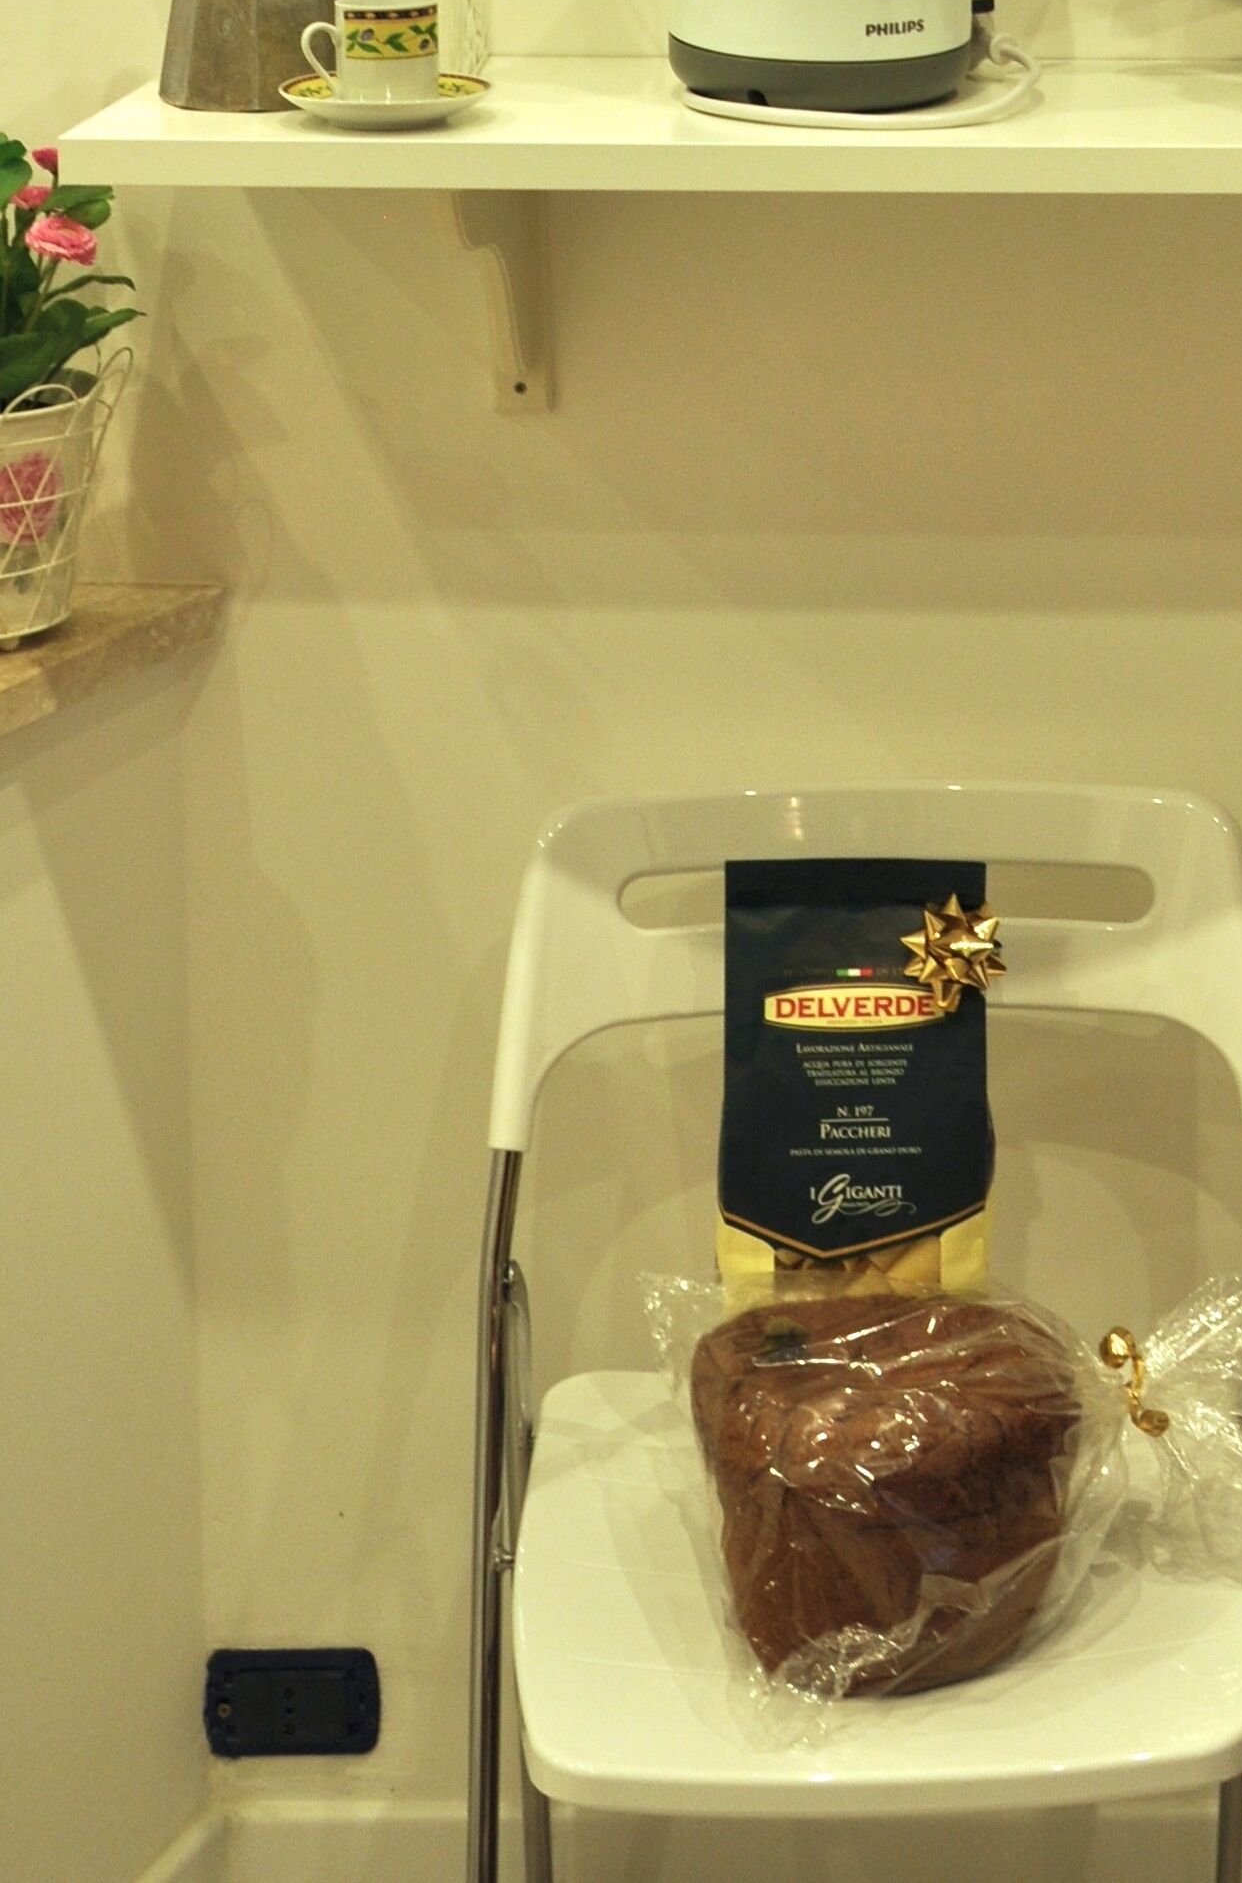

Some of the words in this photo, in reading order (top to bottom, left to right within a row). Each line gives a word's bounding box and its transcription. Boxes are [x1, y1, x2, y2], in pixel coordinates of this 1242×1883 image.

[865, 18, 925, 37] PHILIPS
[775, 995, 935, 1019] DELVERDE
[836, 1105, 851, 1117] N.
[854, 1104, 875, 1117] 197
[819, 1123, 891, 1139] PACCHERI
